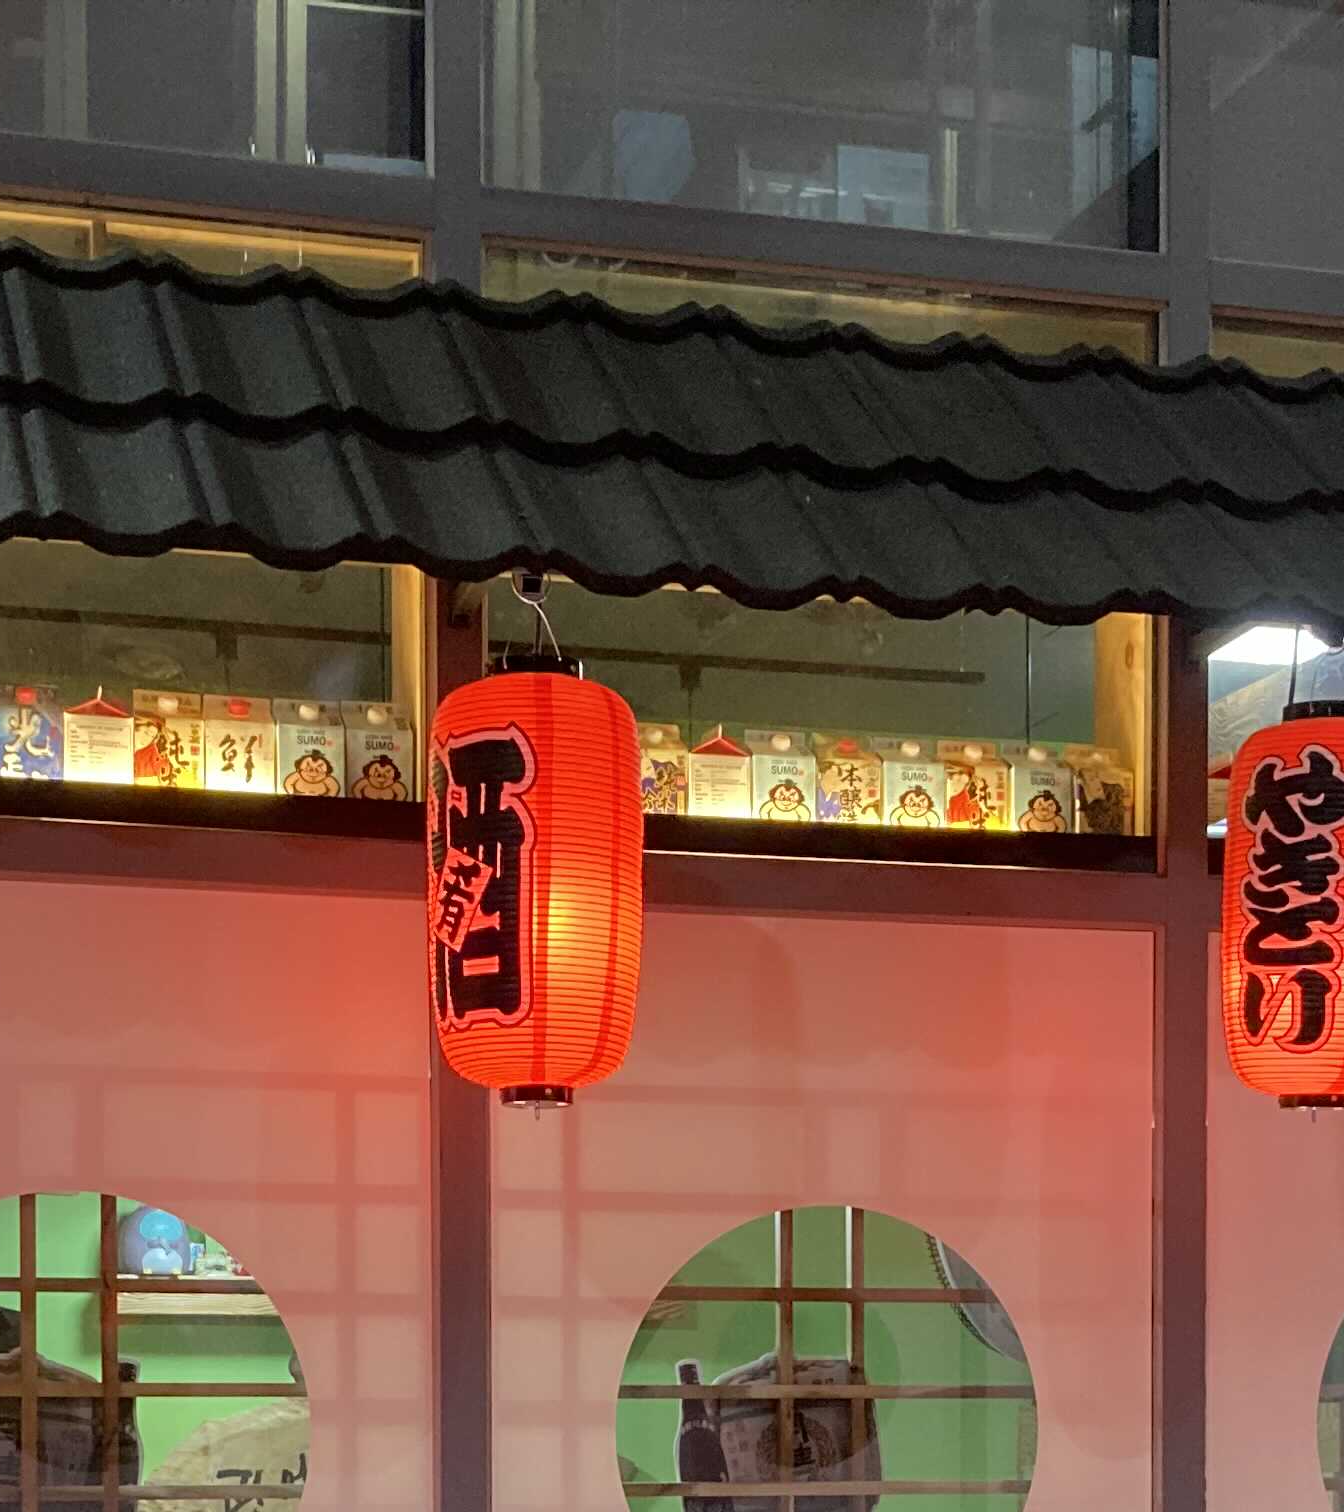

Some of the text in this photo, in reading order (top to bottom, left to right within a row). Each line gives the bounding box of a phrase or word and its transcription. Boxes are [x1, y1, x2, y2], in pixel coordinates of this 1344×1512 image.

[296, 735, 327, 746] SUMO
[364, 741, 394, 751] SUMO
[770, 765, 799, 775] SUMO
[901, 771, 928, 781] SUMO
